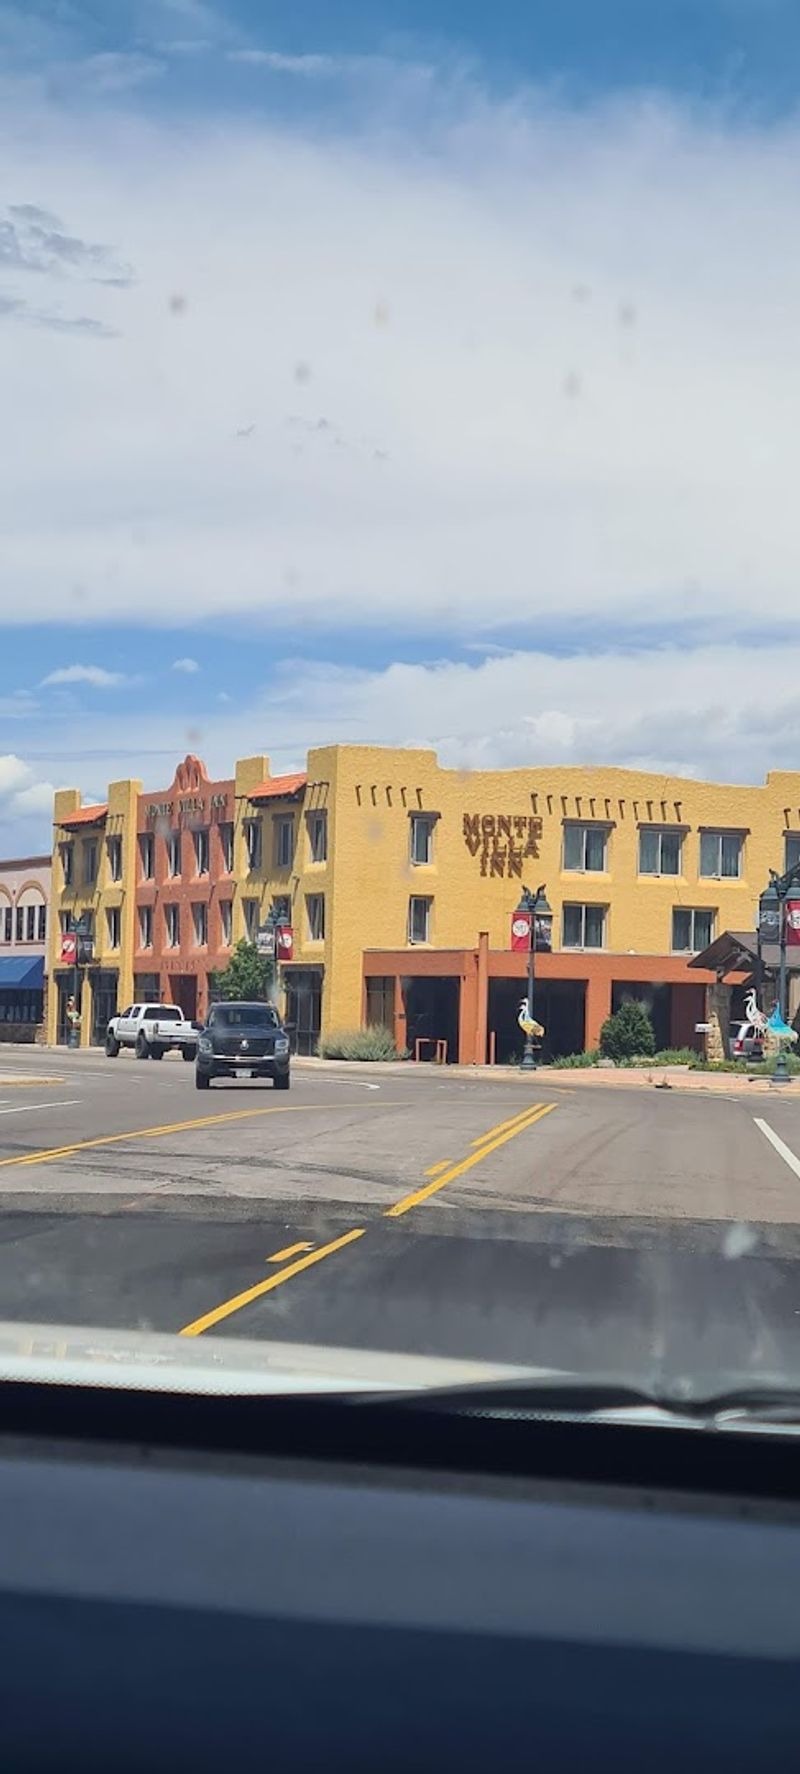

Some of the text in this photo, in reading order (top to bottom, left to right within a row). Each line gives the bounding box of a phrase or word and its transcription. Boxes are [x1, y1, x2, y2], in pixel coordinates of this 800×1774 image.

[462, 813, 543, 838] MONTE
[465, 835, 540, 859] VILLA
[480, 852, 524, 878] INN
